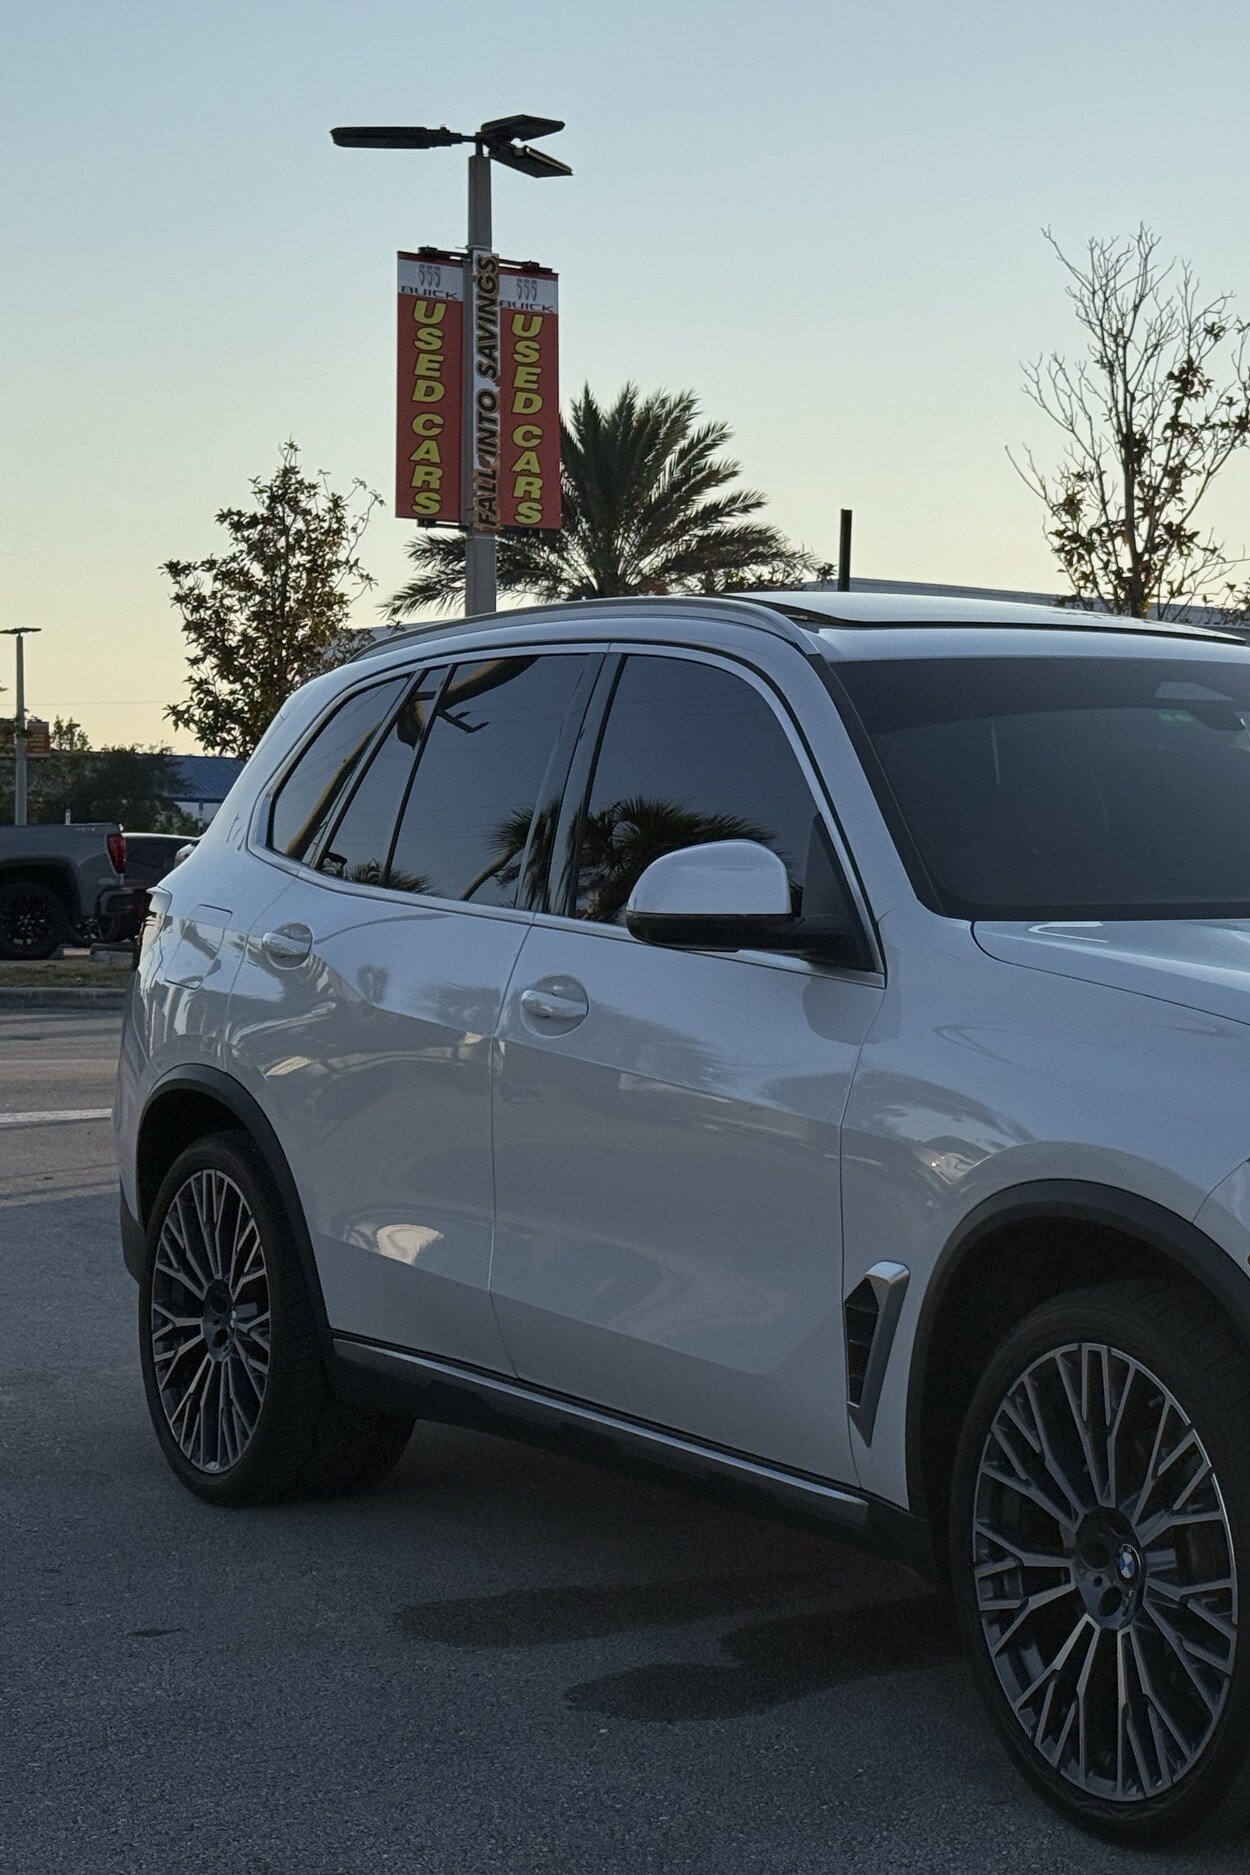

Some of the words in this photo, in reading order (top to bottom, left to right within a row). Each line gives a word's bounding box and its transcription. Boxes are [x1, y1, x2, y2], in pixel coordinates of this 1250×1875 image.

[400, 285, 459, 300] BUICK
[475, 254, 498, 380] SAVINGS
[411, 300, 447, 403] USED
[510, 313, 543, 416] USED
[408, 412, 445, 516] CARS
[475, 389, 498, 457] INTO
[476, 468, 498, 528] FALL
[510, 424, 544, 526] CARS
